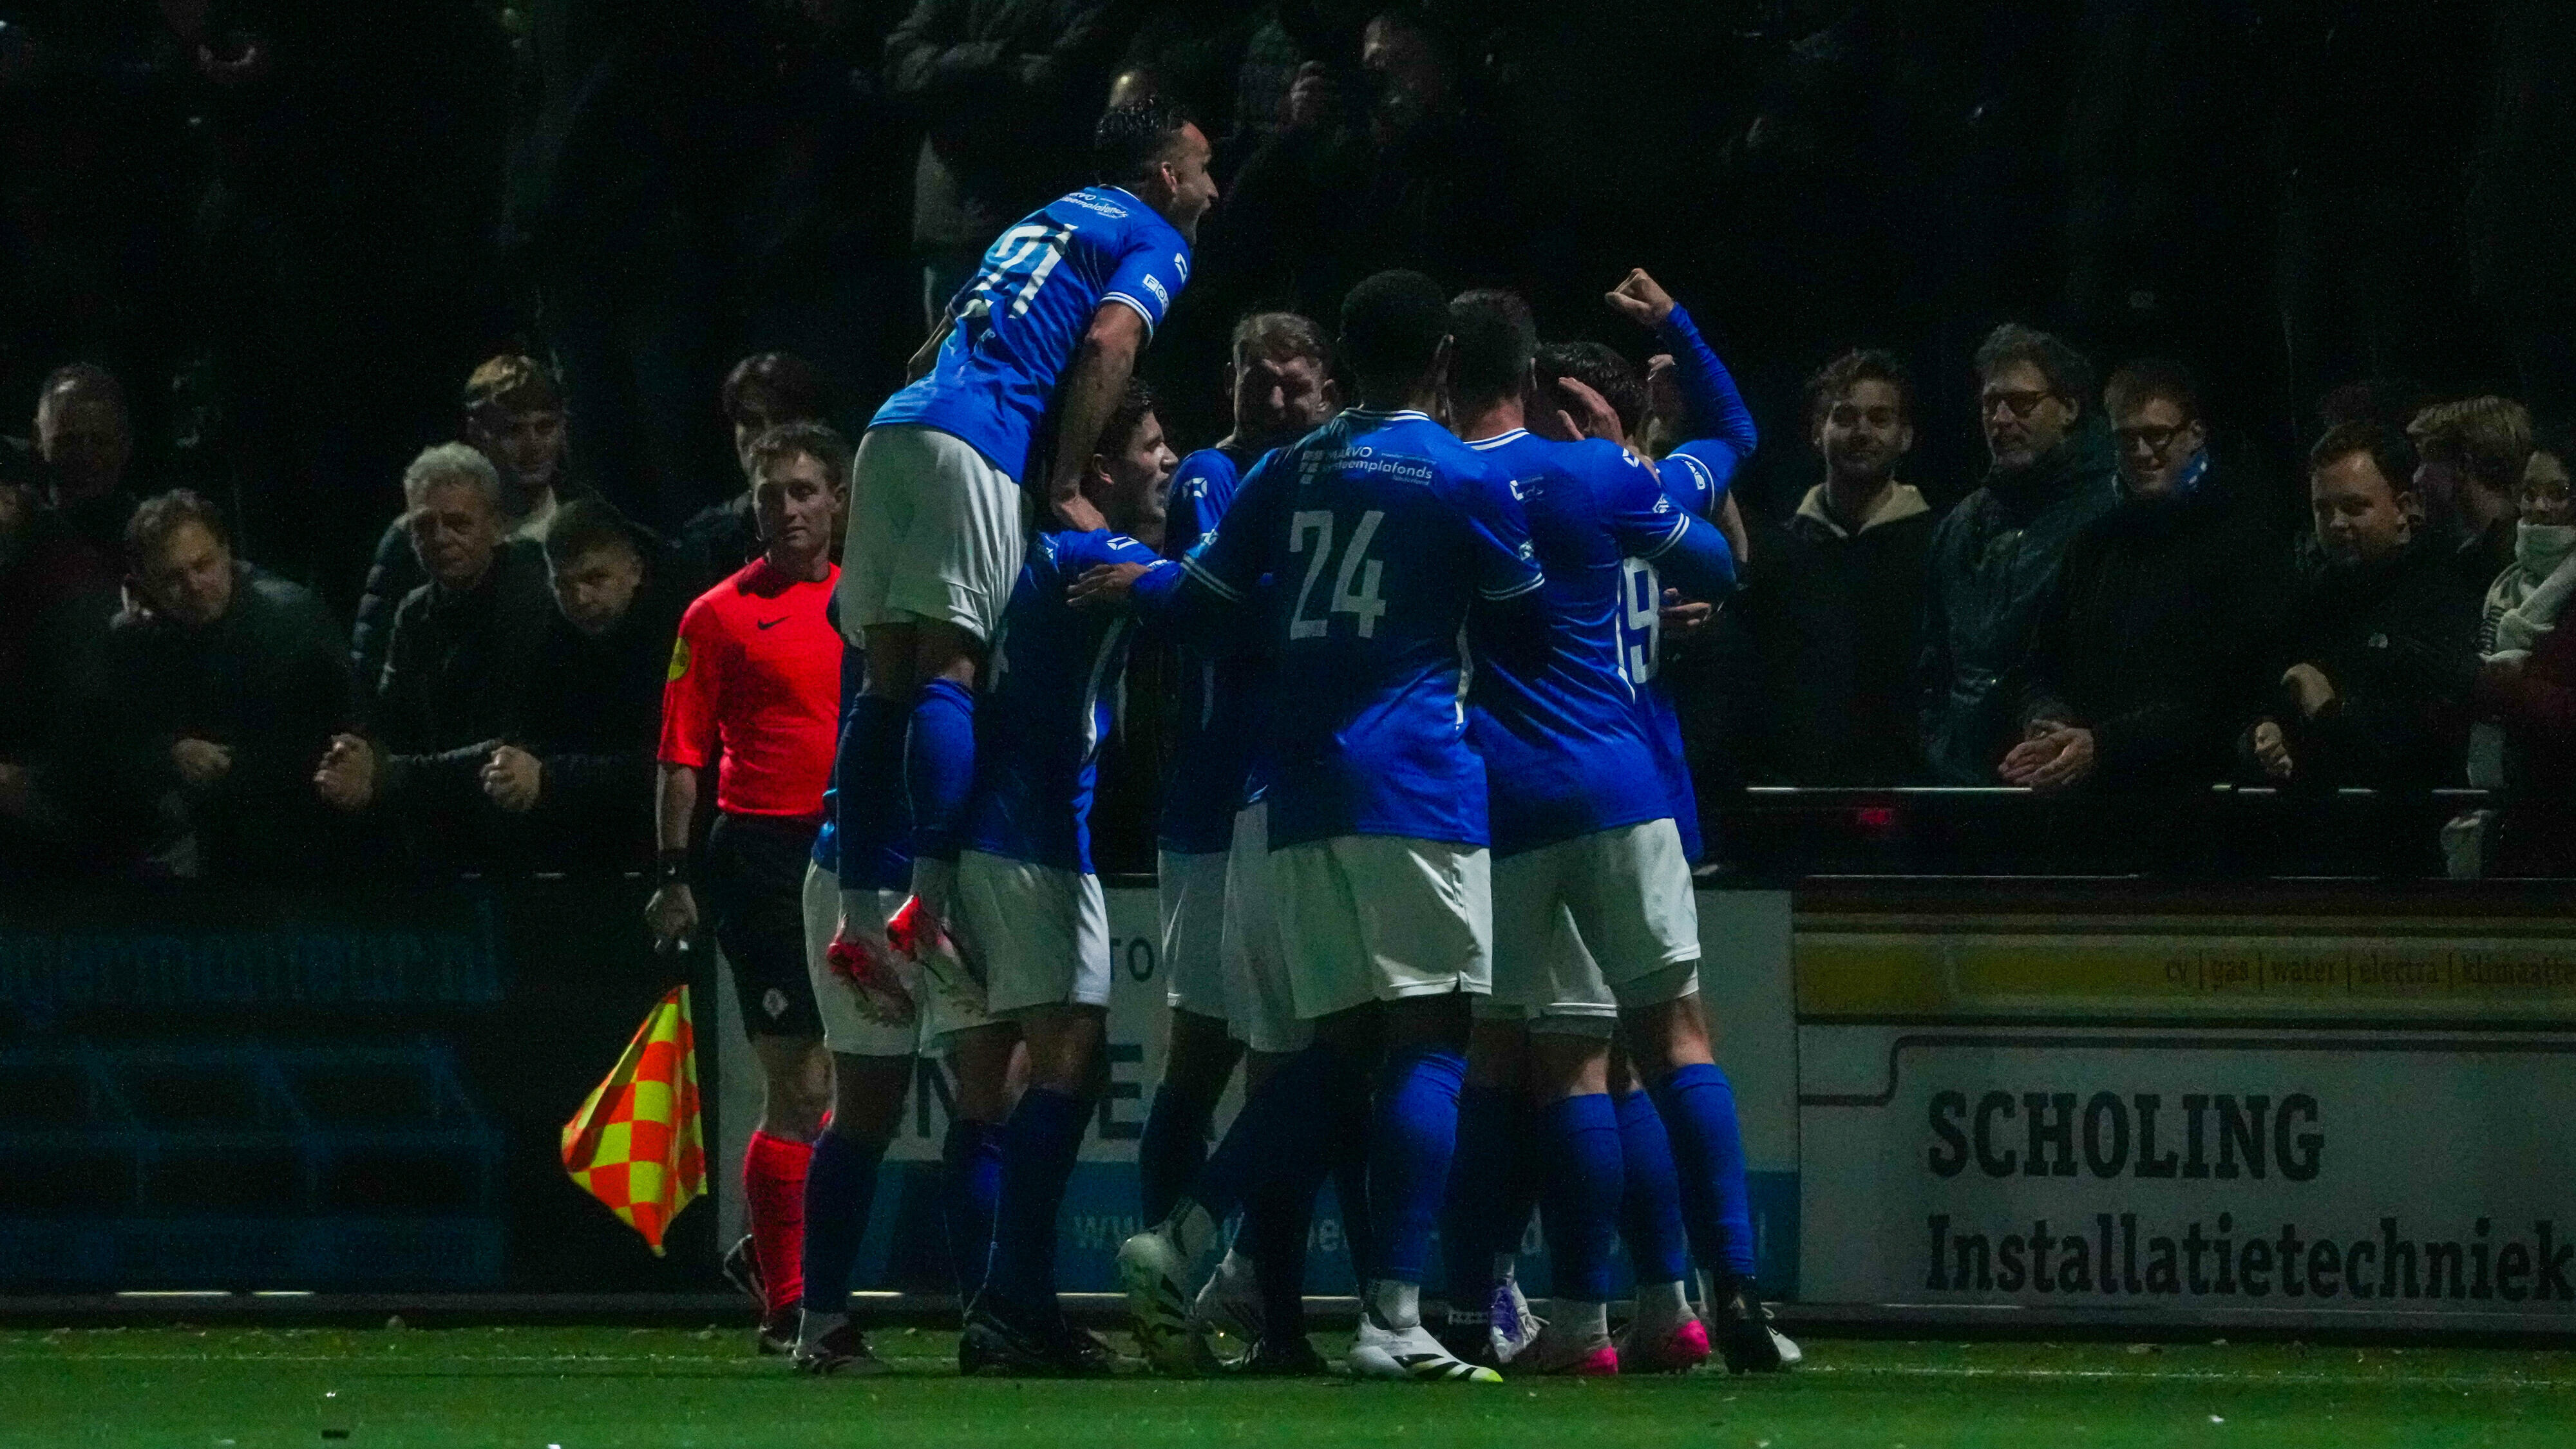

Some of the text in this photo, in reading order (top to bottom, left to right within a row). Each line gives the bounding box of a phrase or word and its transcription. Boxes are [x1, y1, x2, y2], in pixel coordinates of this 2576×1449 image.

[1289, 510, 1387, 639] 24
[2210, 958, 2249, 996] gas
[2271, 955, 2336, 985] water
[2360, 954, 2439, 985] electra
[1927, 1089, 2324, 1180] SCHOLING
[1926, 1213, 2576, 1302] Installatietechniek
